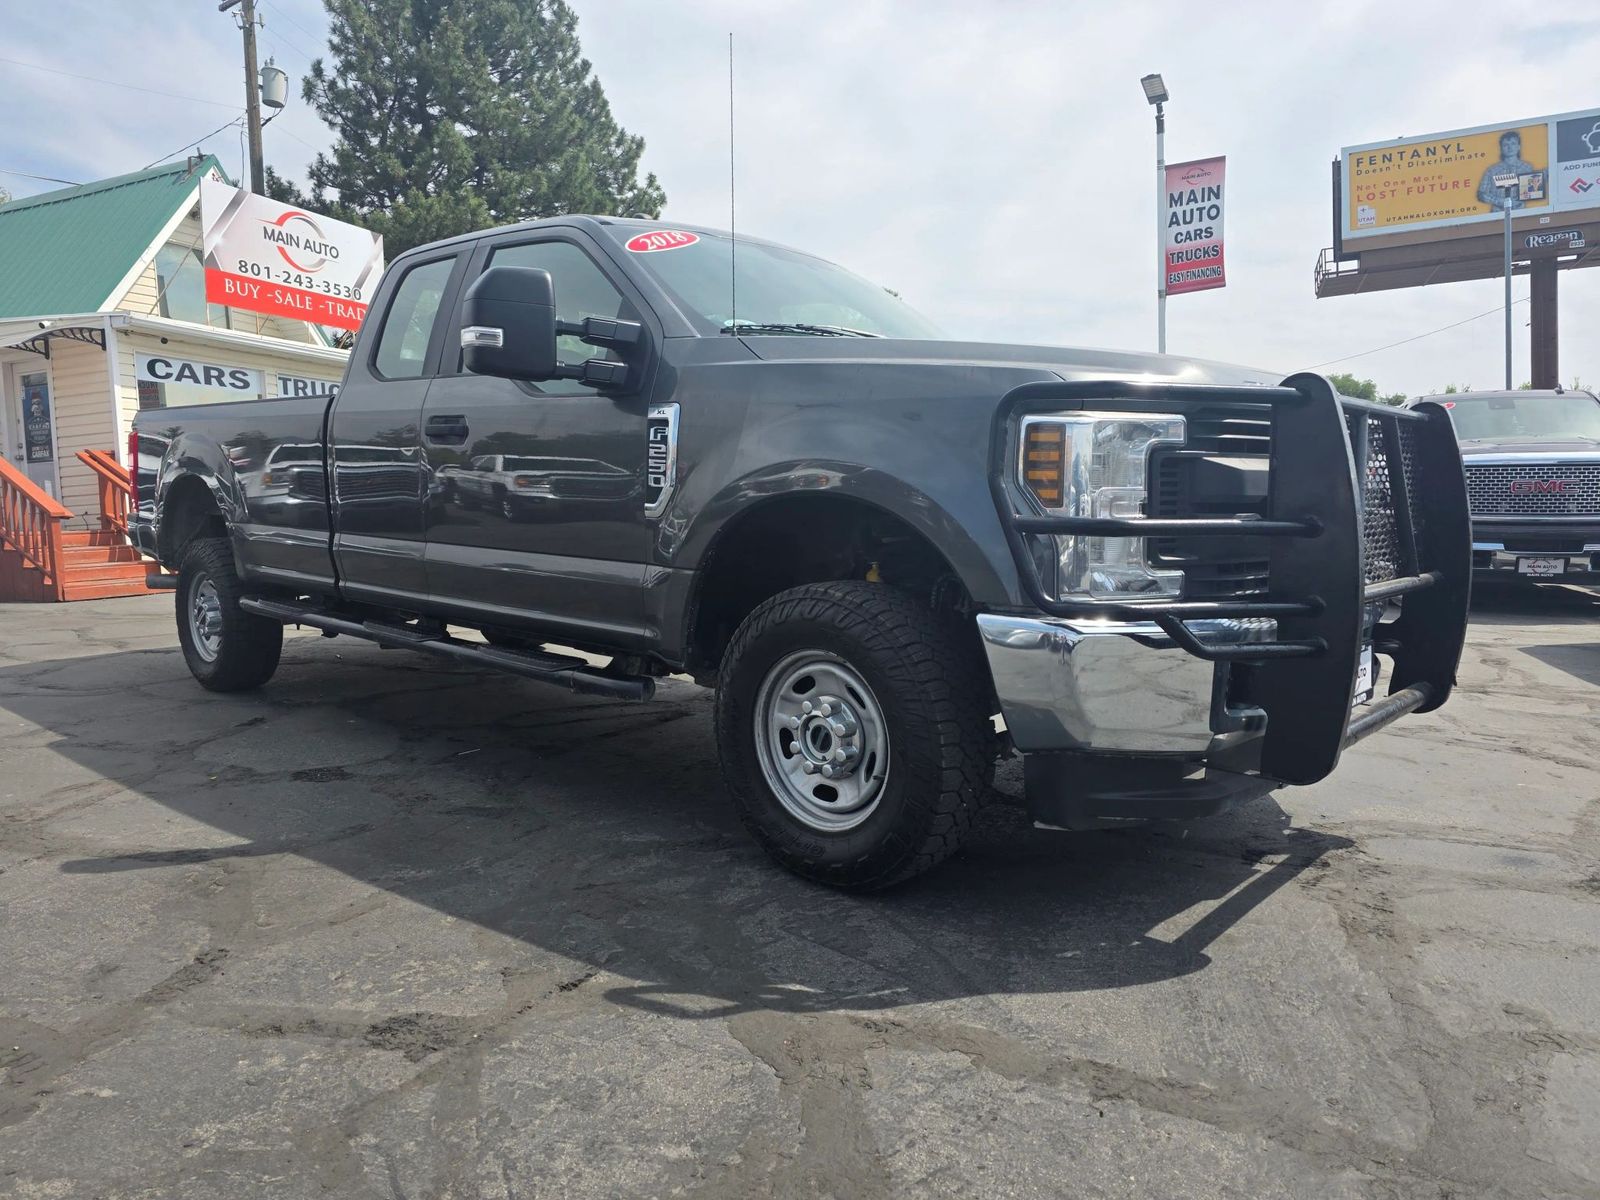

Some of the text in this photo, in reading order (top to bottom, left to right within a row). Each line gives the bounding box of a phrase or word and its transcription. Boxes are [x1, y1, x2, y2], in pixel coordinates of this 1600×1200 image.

[1356, 142, 1465, 168] FENTANYL
[1356, 152, 1486, 176] Doesn't Discriminate
[1356, 184, 1377, 192] Not
[1413, 175, 1443, 183] More
[1356, 179, 1471, 202] LOST FUTURE
[1169, 184, 1221, 208] MAIN
[1168, 204, 1220, 228] AUTO
[1386, 206, 1477, 222] UTAHNALOXONE.ORG
[263, 226, 340, 259] MAIN AUTO
[639, 231, 687, 250] 2018
[1174, 226, 1214, 244] CARS
[1529, 231, 1578, 248] Reagan
[1169, 244, 1220, 265] TRUCKS
[238, 259, 362, 300] 801-243-3530
[1169, 266, 1222, 284] EASY FINANCING
[224, 278, 261, 299] BUY
[146, 358, 251, 390] CARS
[648, 425, 668, 488] F250
[1510, 479, 1580, 494] GMC
